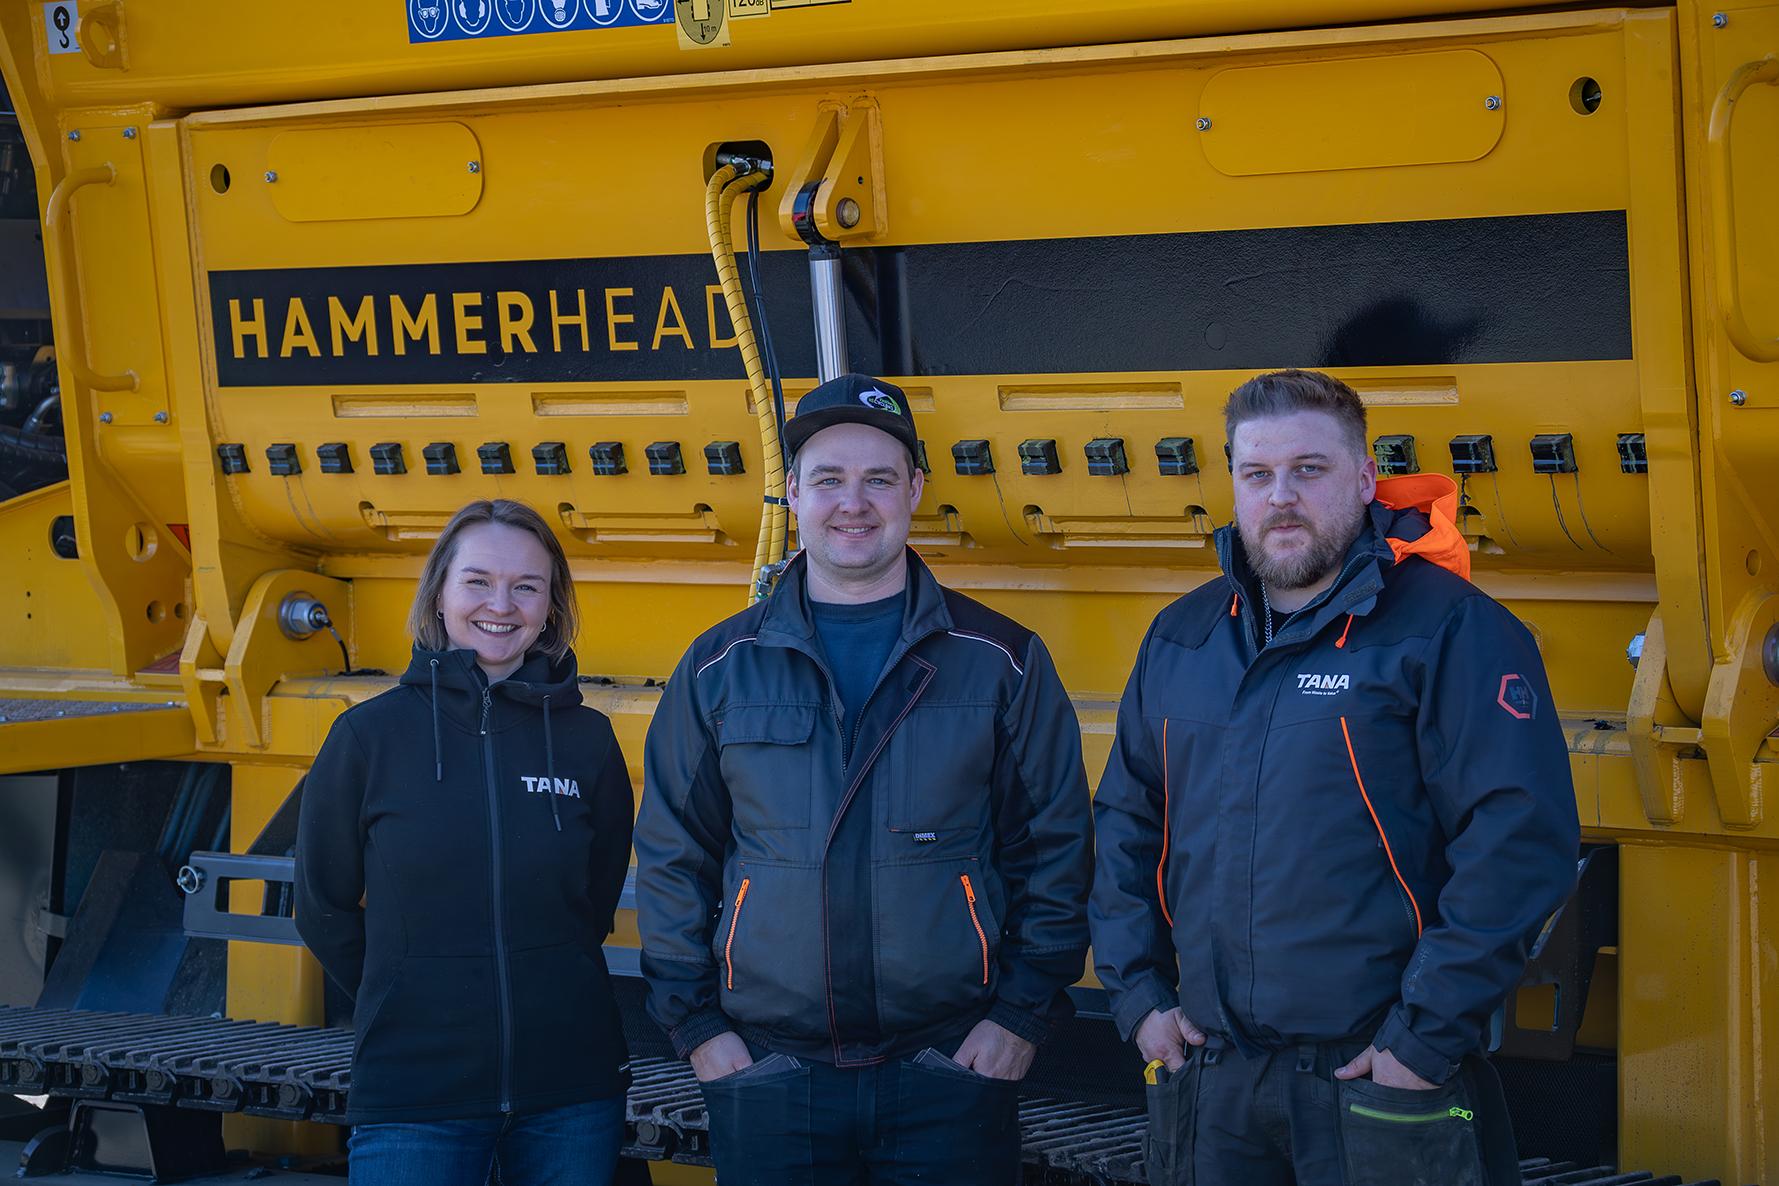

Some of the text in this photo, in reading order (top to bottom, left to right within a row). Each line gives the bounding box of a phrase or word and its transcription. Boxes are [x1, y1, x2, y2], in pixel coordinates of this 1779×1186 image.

[229, 285, 739, 358] HAMMERHEAD
[1297, 673, 1350, 690] TANA
[520, 776, 581, 799] TANA
